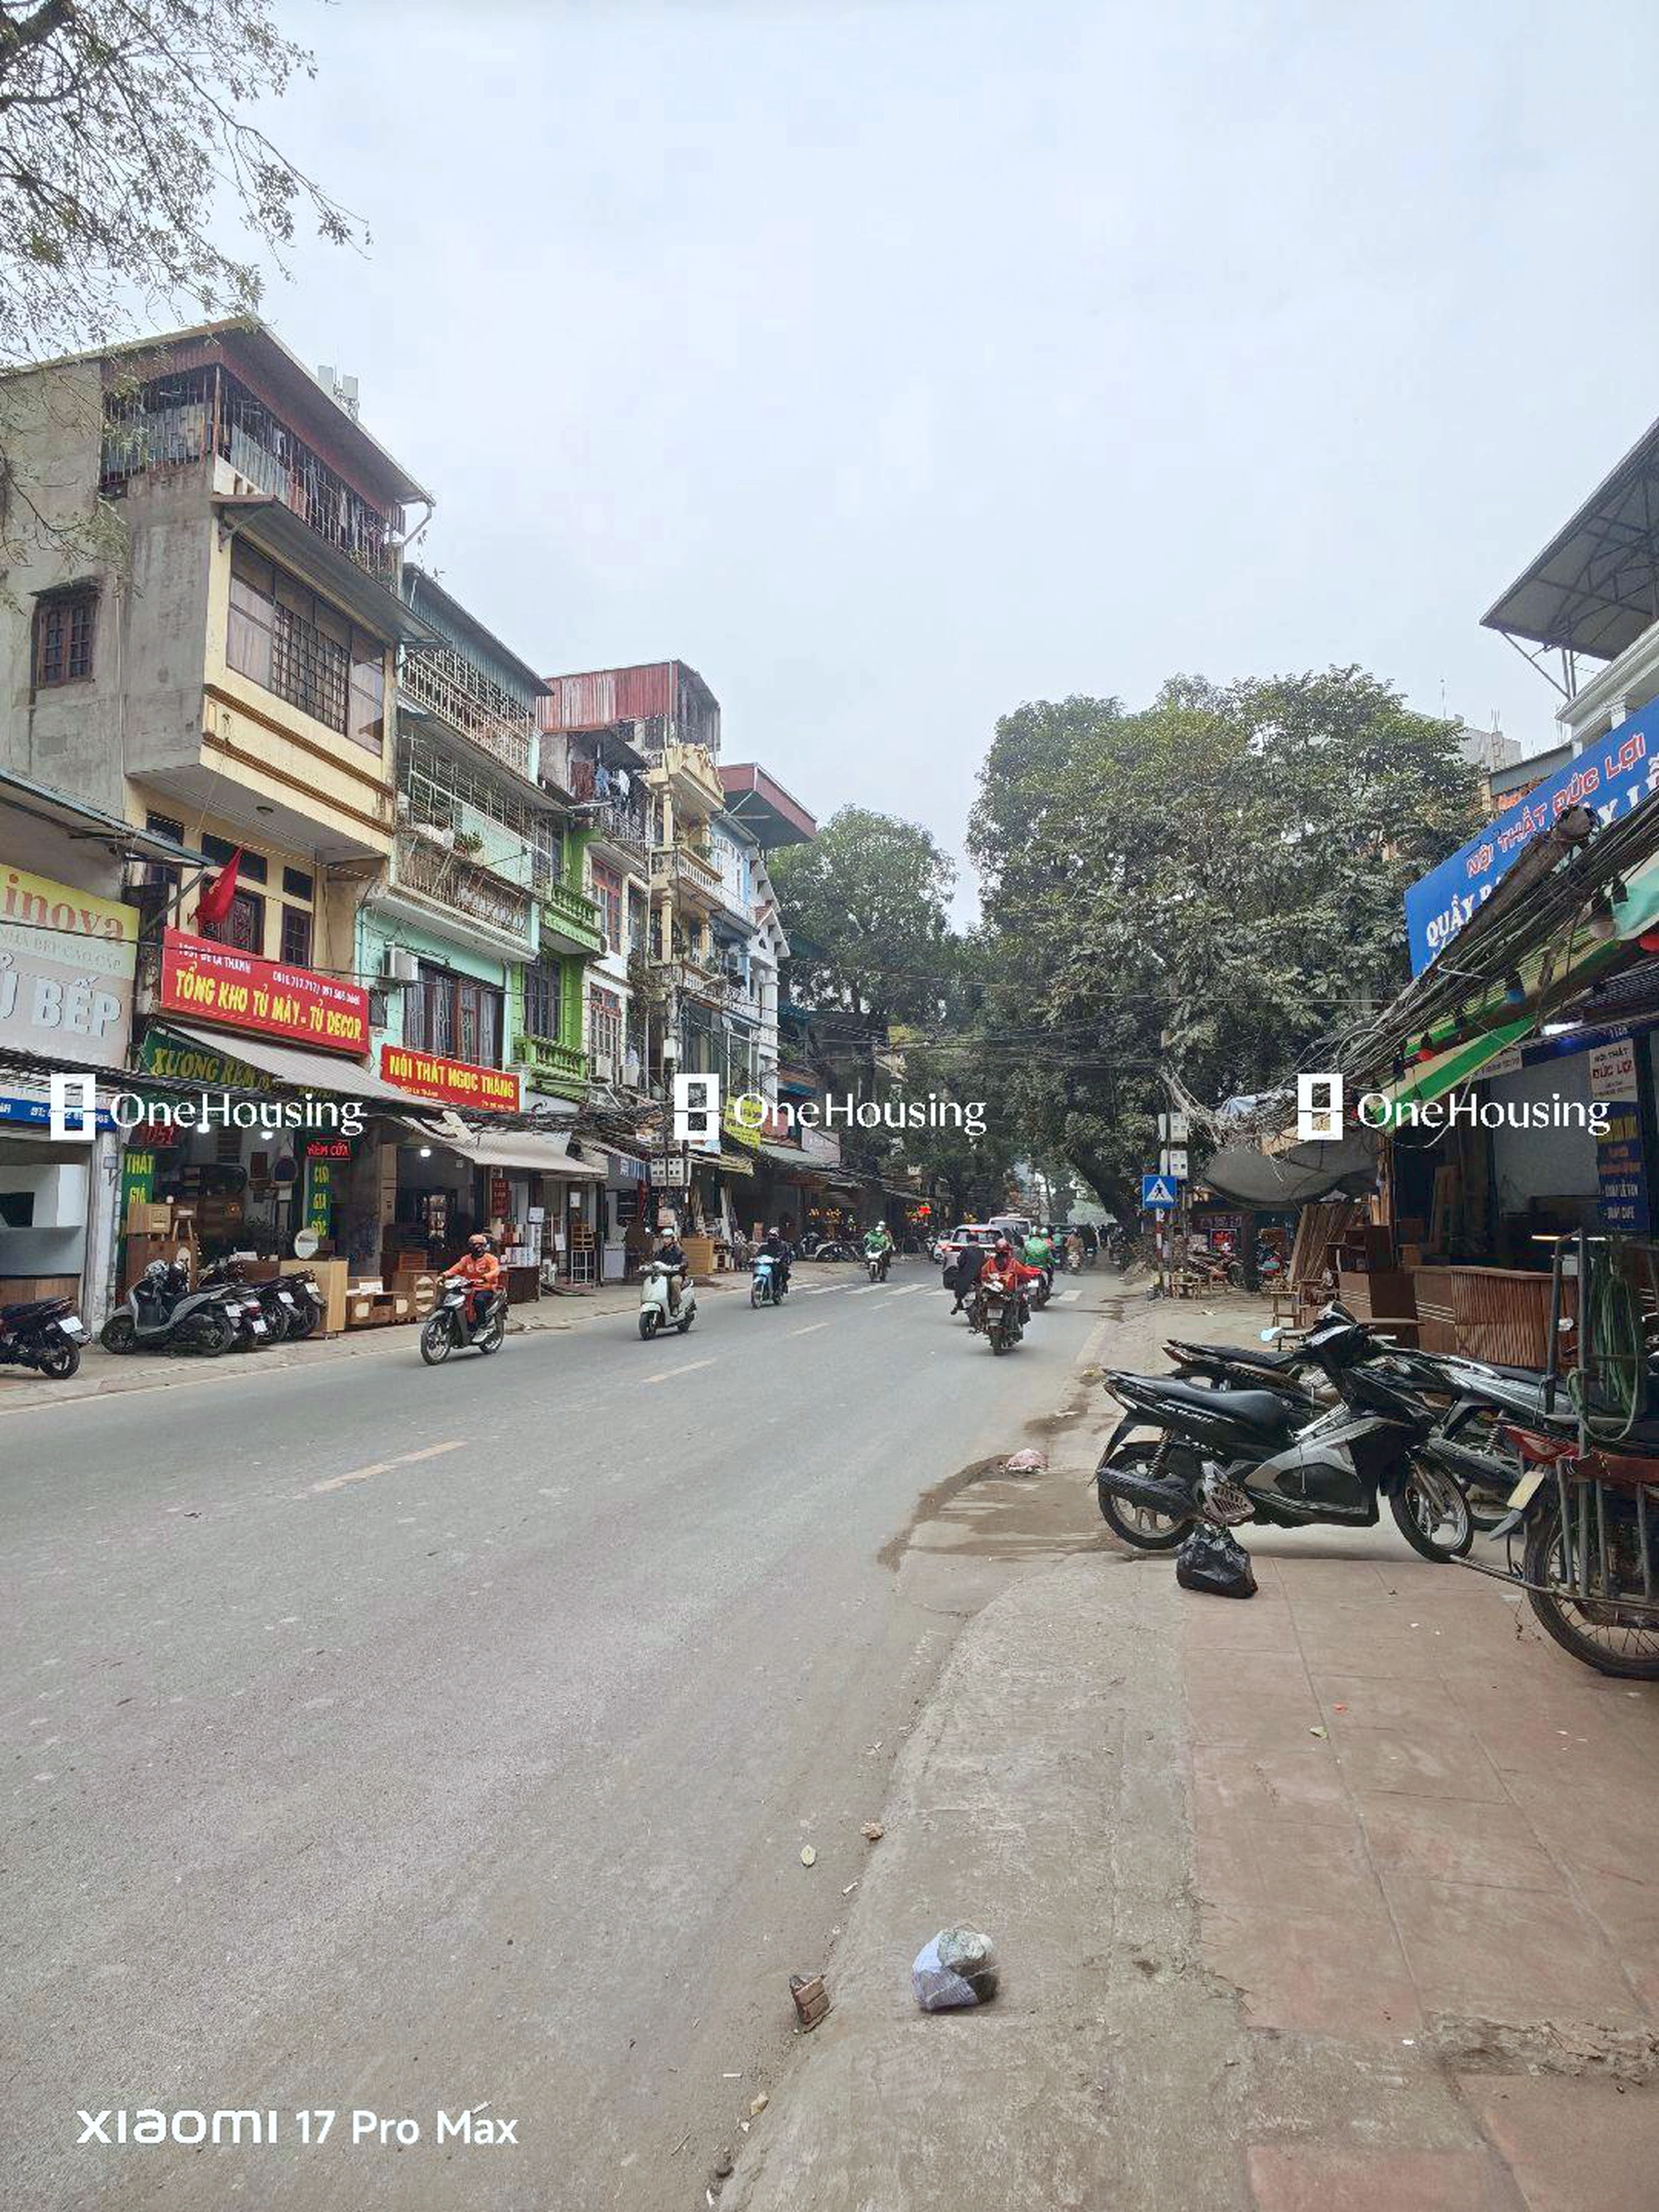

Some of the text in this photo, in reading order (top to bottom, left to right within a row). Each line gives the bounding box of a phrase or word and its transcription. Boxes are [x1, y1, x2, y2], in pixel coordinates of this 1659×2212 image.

[1605, 732, 1646, 780] LỢI
[31, 975, 123, 1038] BẾP
[176, 960, 216, 1005] TỔNG
[218, 982, 249, 1011] KHO
[253, 983, 269, 1017] TỦ
[309, 998, 324, 1032] TỦ
[326, 1010, 363, 1043] DECOR
[389, 1053, 413, 1081] NỘI
[447, 1067, 479, 1094] NGỌC
